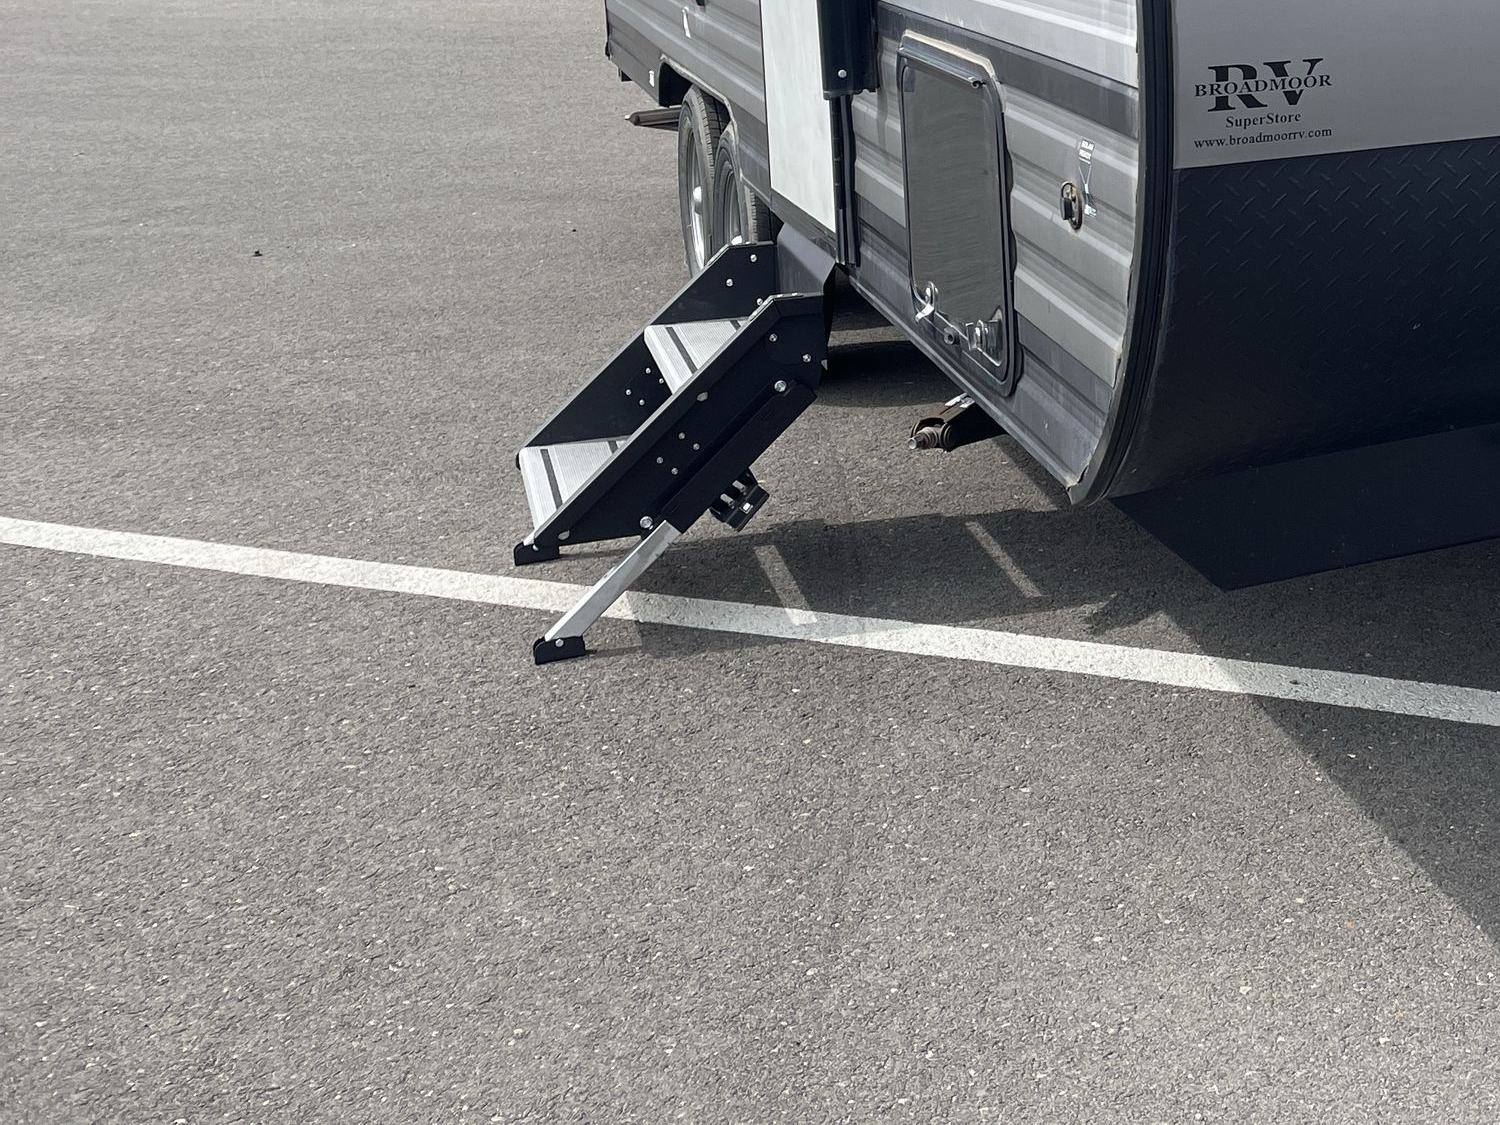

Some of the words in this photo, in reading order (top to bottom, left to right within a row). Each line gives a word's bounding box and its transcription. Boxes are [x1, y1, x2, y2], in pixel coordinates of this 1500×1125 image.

[1194, 74, 1332, 97] BROADMOOR
[1208, 58, 1323, 112] RV
[1225, 112, 1302, 129] SuperStore
[1194, 127, 1332, 148] www.broadmoorrv.com
